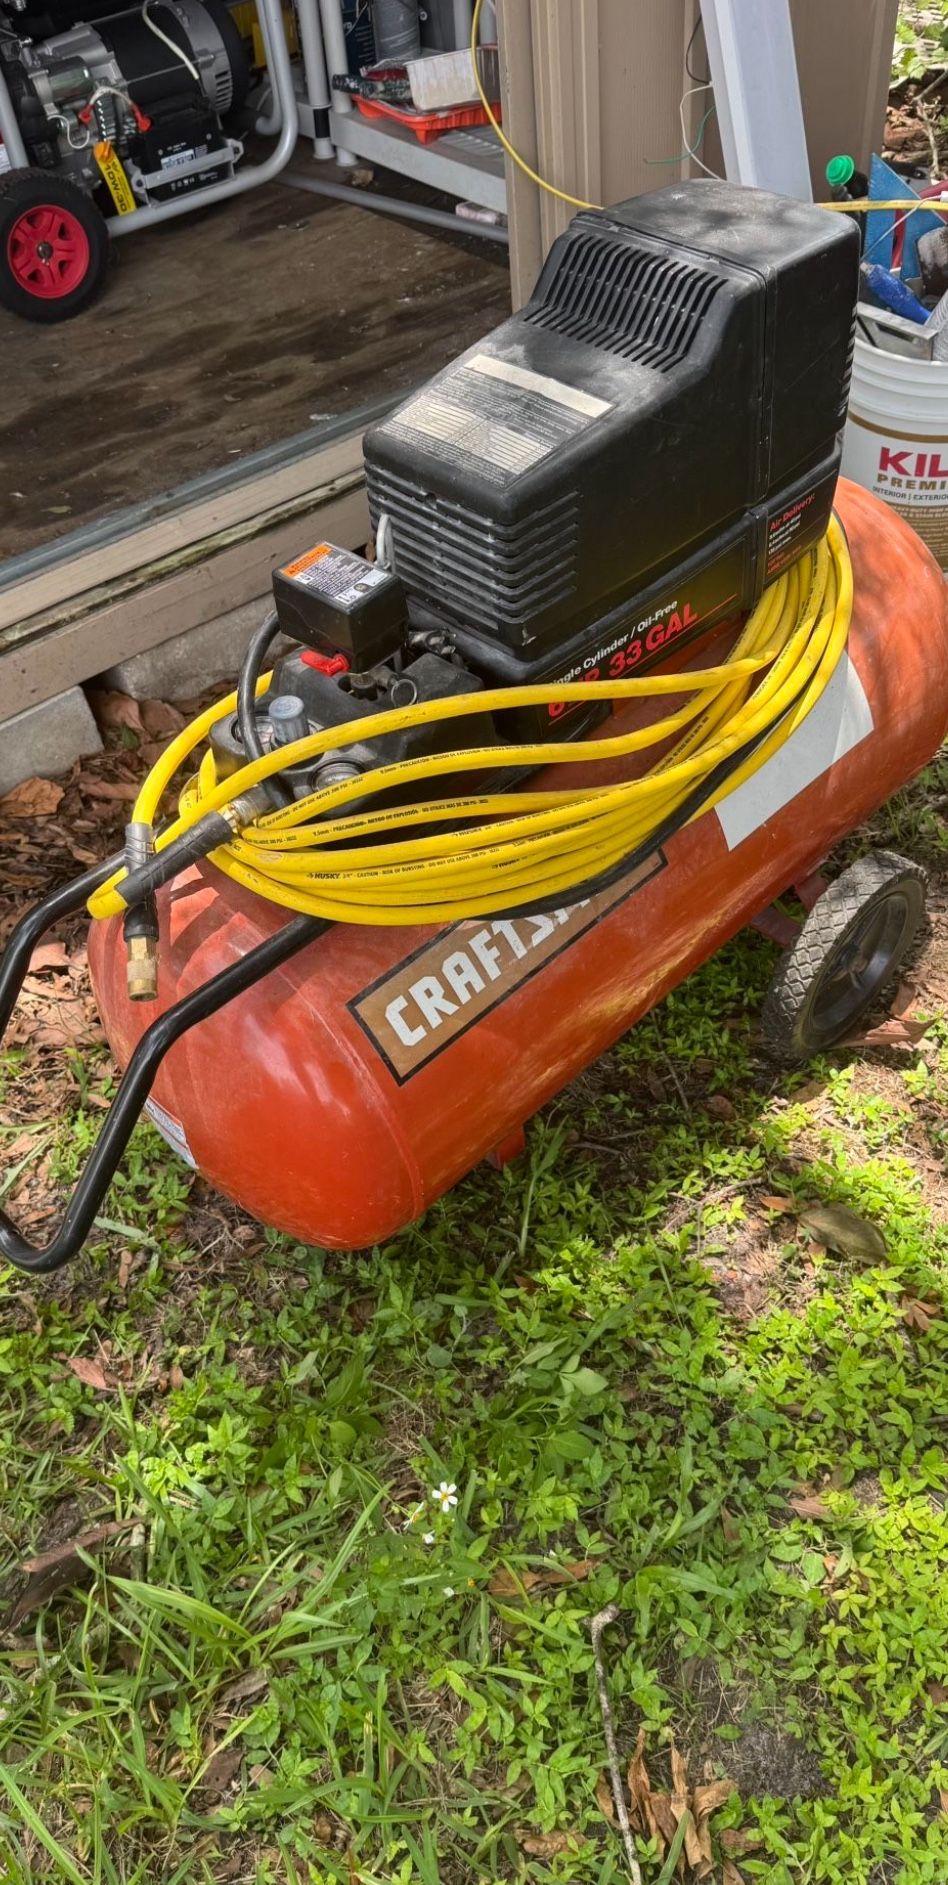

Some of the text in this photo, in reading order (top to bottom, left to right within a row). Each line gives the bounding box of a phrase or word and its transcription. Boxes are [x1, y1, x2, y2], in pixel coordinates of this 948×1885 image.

[879, 446, 948, 478] KIL
[872, 485, 907, 499] INTERIOR
[877, 473, 947, 490] PREMI
[549, 665, 582, 685] ingle
[583, 633, 629, 669] Cylinder
[637, 600, 678, 632] Oil-Free
[608, 639, 642, 677] 33
[645, 602, 699, 651] GAL
[314, 872, 341, 880] HUSKY
[384, 894, 597, 1047] CRAFTS
